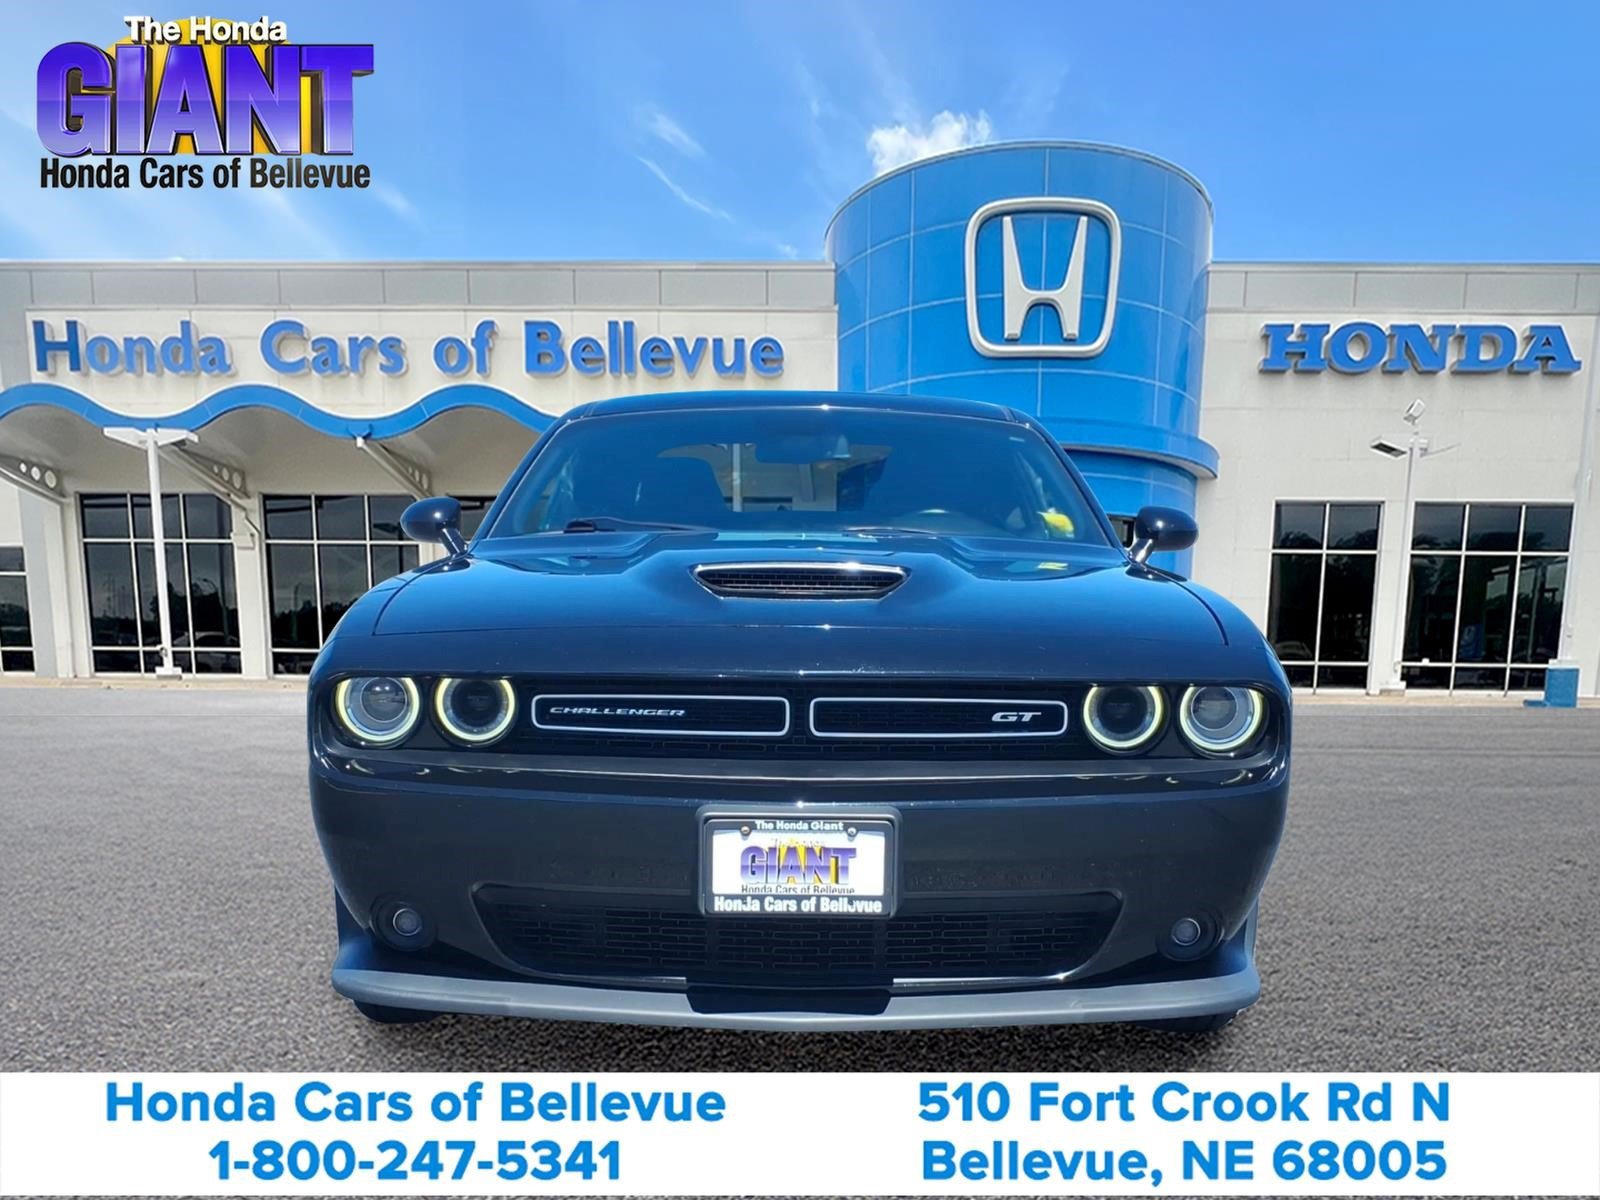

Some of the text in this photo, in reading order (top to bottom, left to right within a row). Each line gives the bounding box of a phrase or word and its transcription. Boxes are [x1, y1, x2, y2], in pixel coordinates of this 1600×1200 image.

[33, 320, 785, 376] Honda Cars of Bellevue
[1259, 322, 1582, 374] HONDA
[550, 706, 685, 716] CHALLENGER
[991, 711, 1042, 722] GT
[755, 820, 844, 831] The Honda Giant
[740, 845, 857, 884] GIANT
[763, 896, 798, 912] Cars
[800, 896, 816, 912] of
